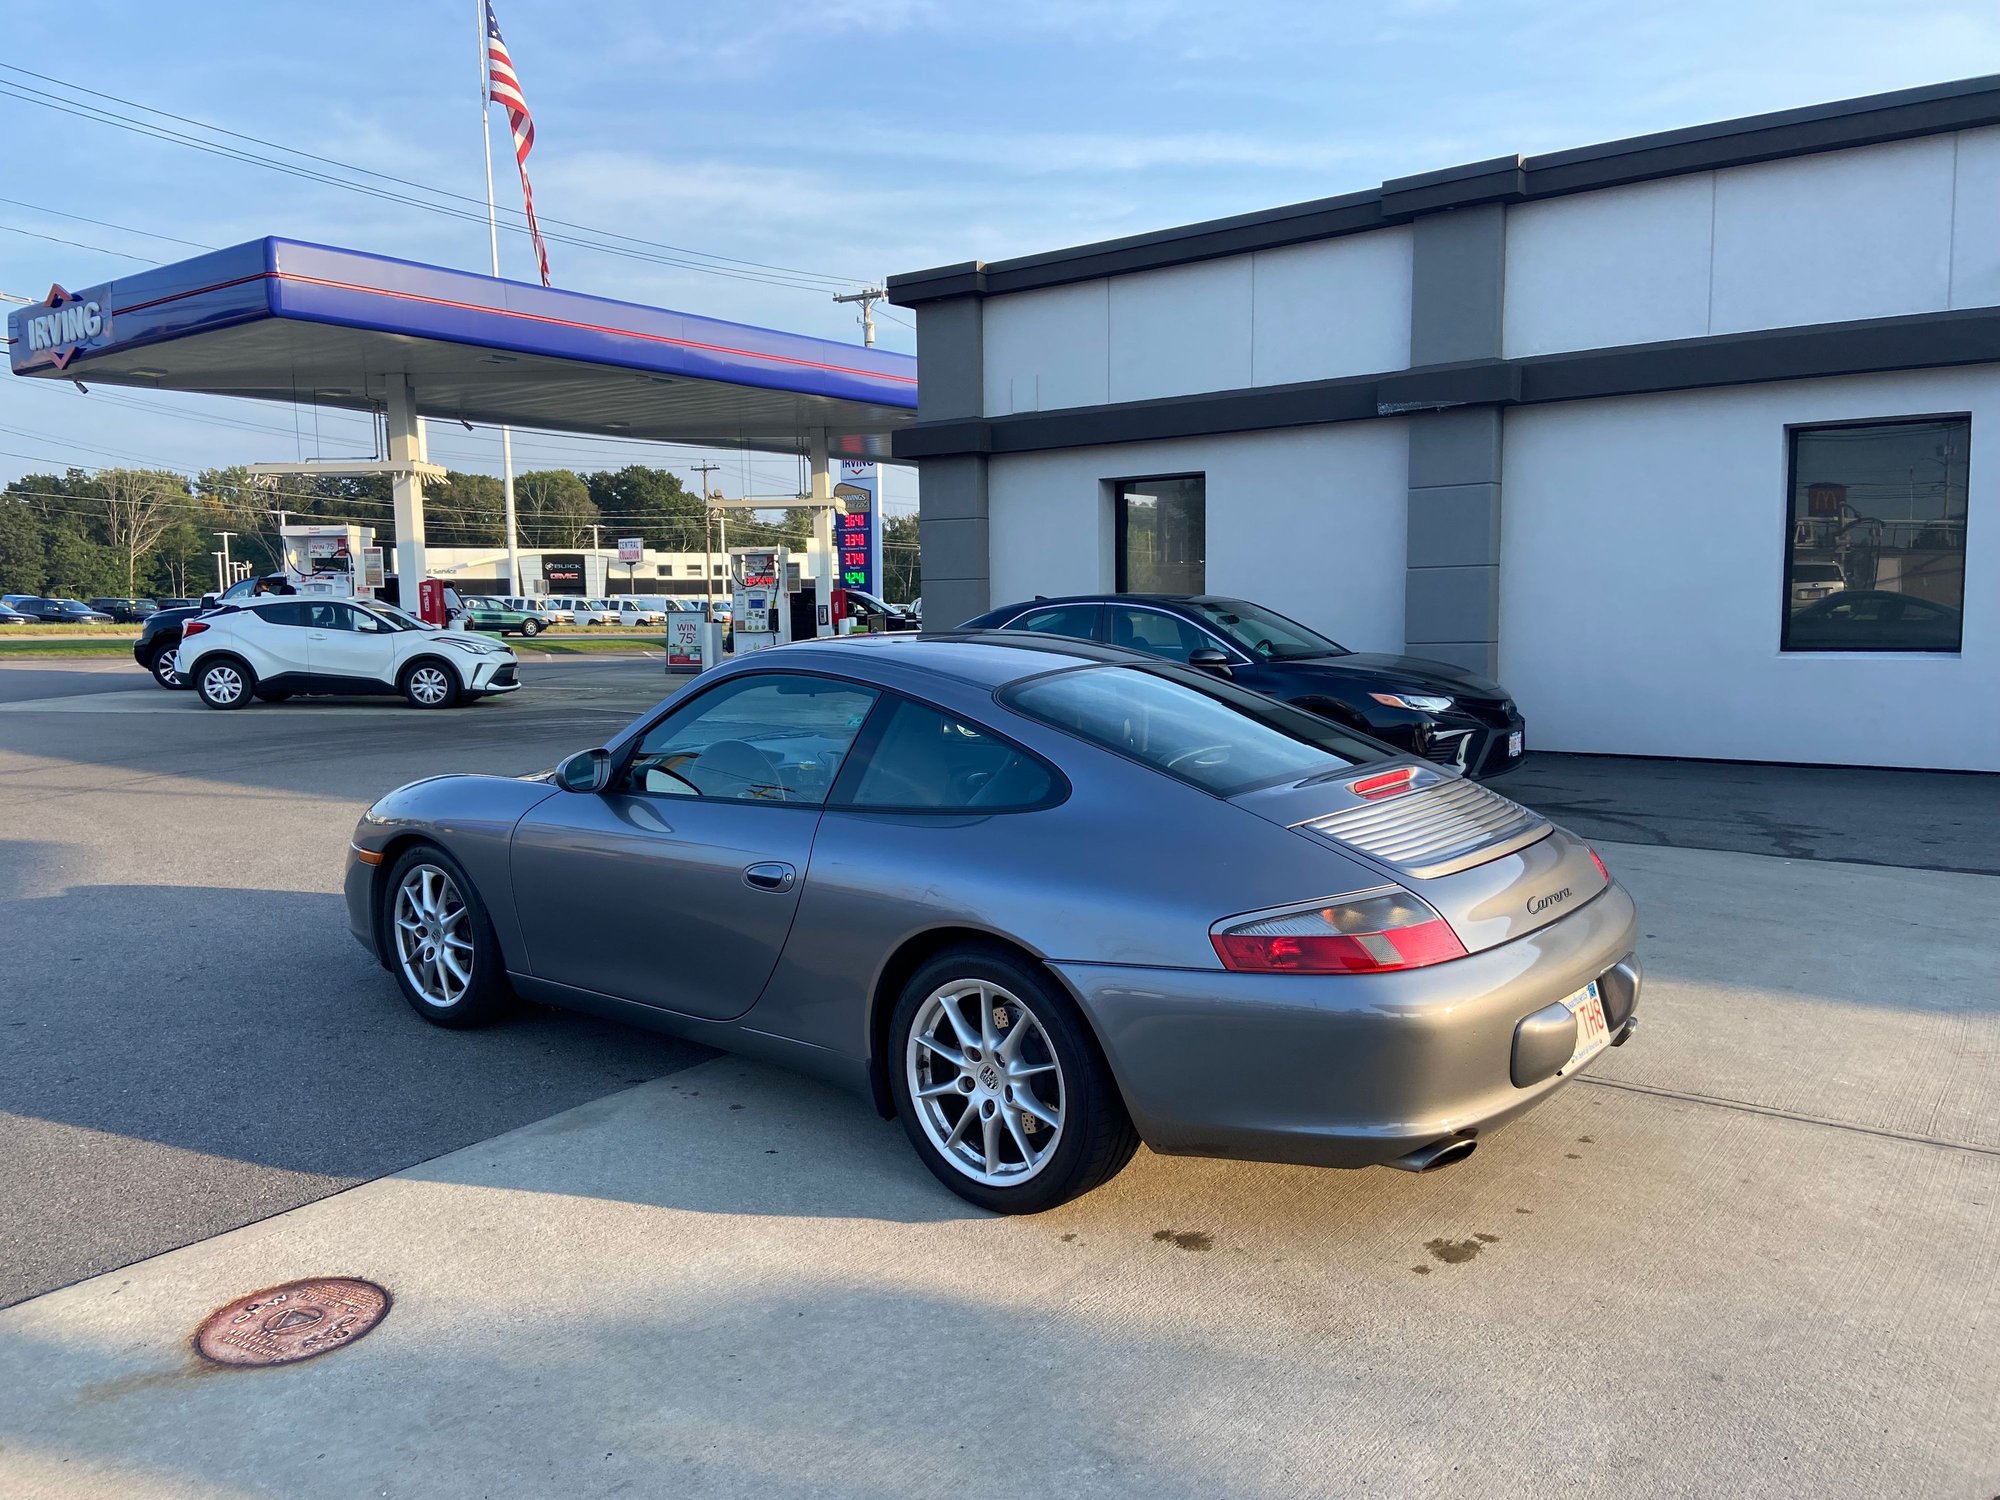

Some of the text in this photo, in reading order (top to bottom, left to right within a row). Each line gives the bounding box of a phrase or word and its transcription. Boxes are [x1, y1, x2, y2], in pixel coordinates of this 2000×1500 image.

[28, 302, 102, 351] IRVING
[677, 624, 697, 632] WIN
[1526, 887, 1573, 915] Carrera
